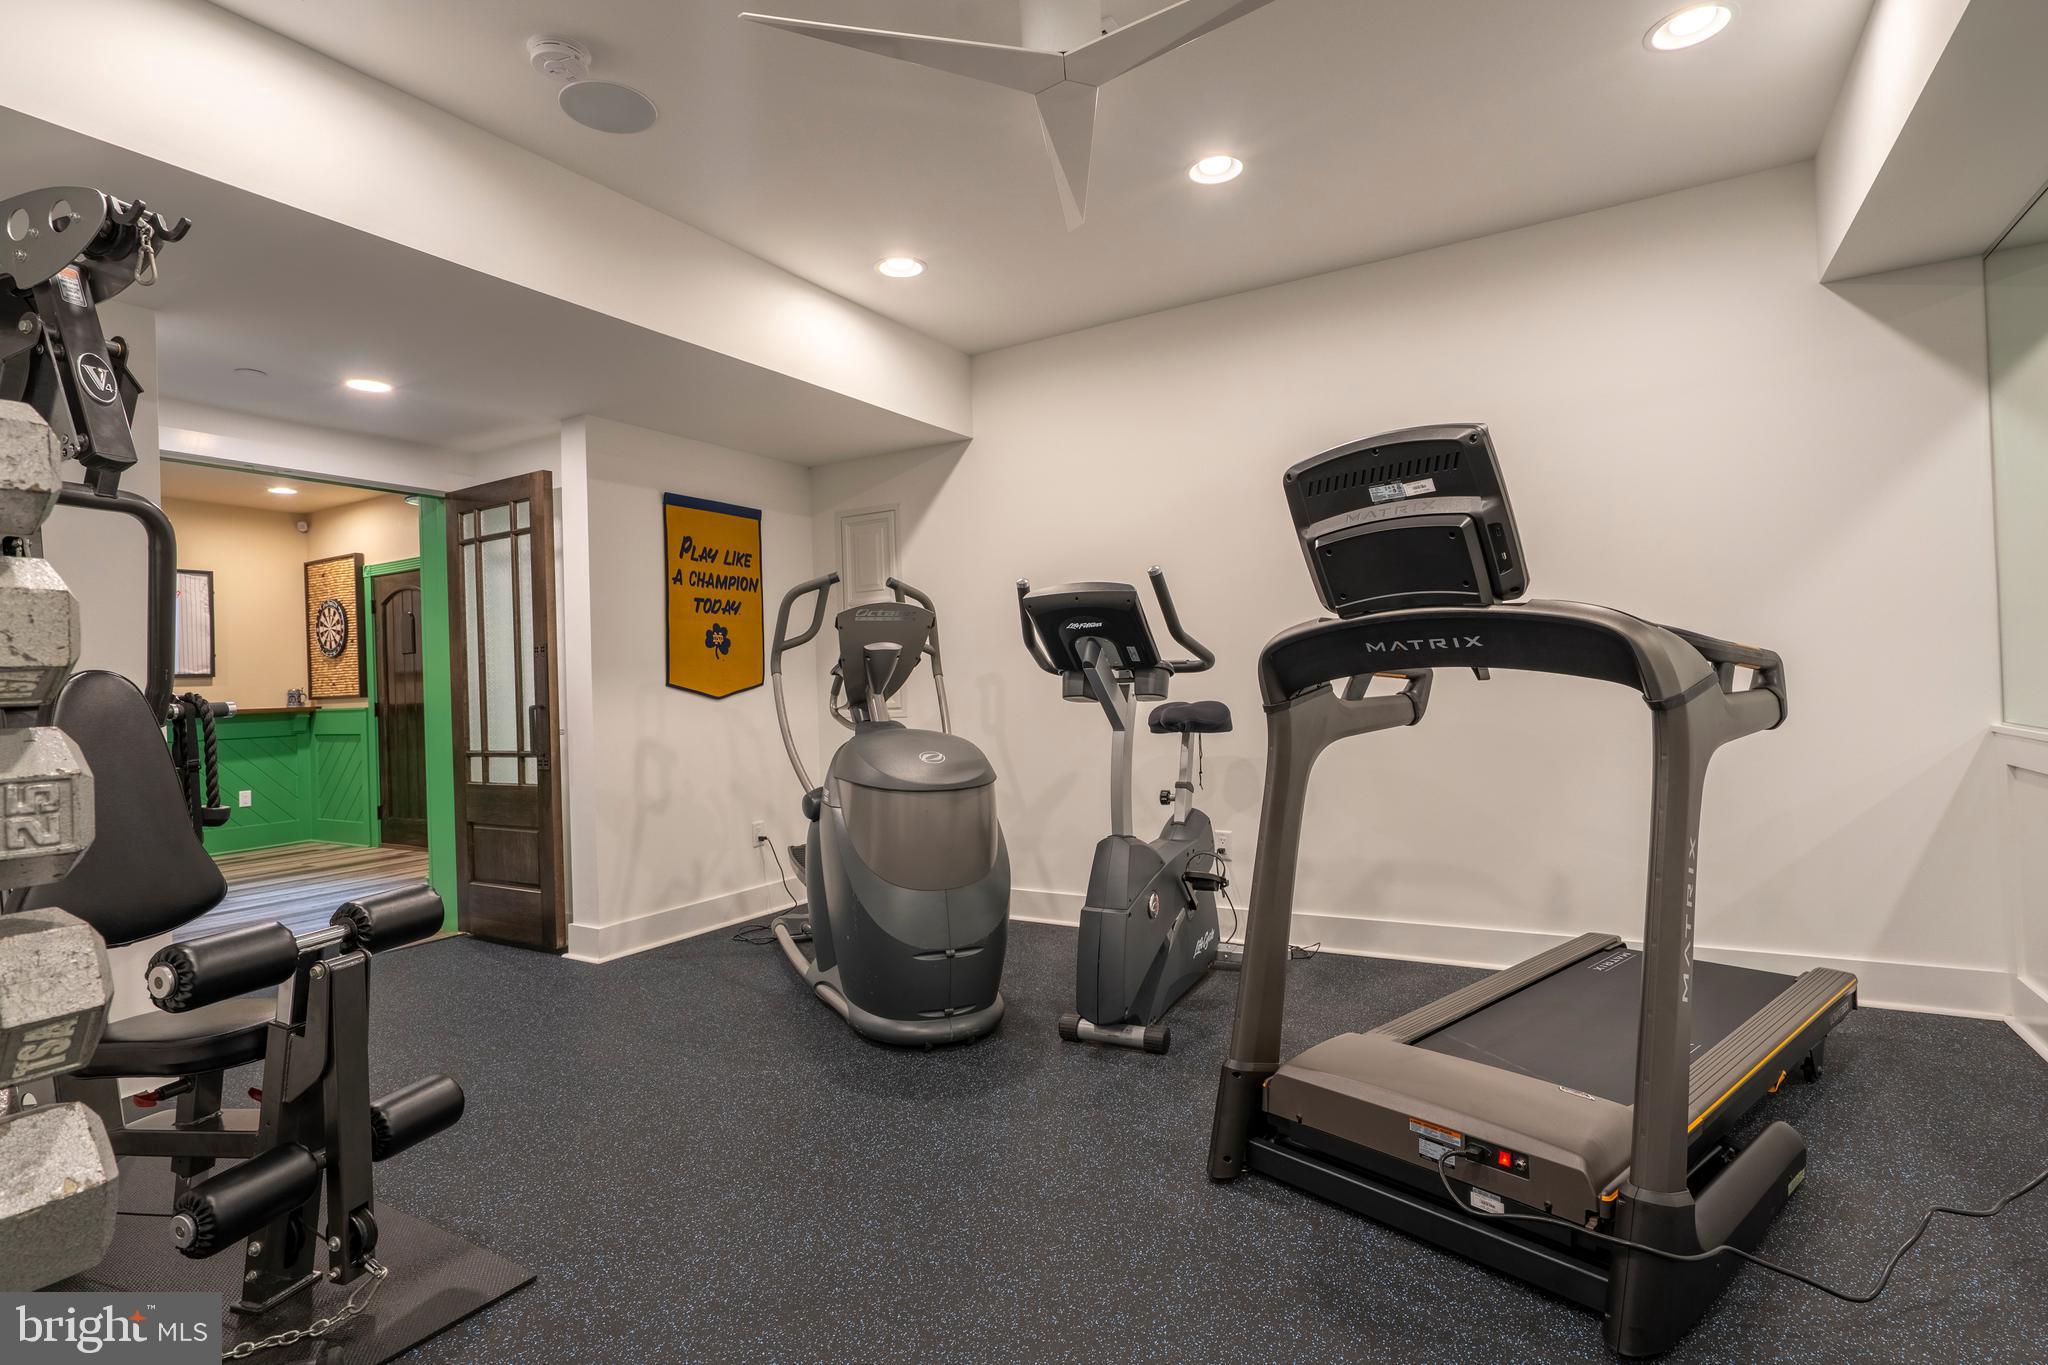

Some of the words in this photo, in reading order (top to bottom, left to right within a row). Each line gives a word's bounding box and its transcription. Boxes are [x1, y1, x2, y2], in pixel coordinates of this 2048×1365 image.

[1345, 499, 1436, 524] MATRIX
[679, 535, 719, 564] PLAY
[723, 549, 753, 568] LIKE
[671, 568, 684, 586] A
[688, 570, 760, 593] CHAMPION
[1365, 635, 1484, 653] MATRIX
[4, 783, 61, 850] 25
[1681, 836, 1697, 1003] MATRIX
